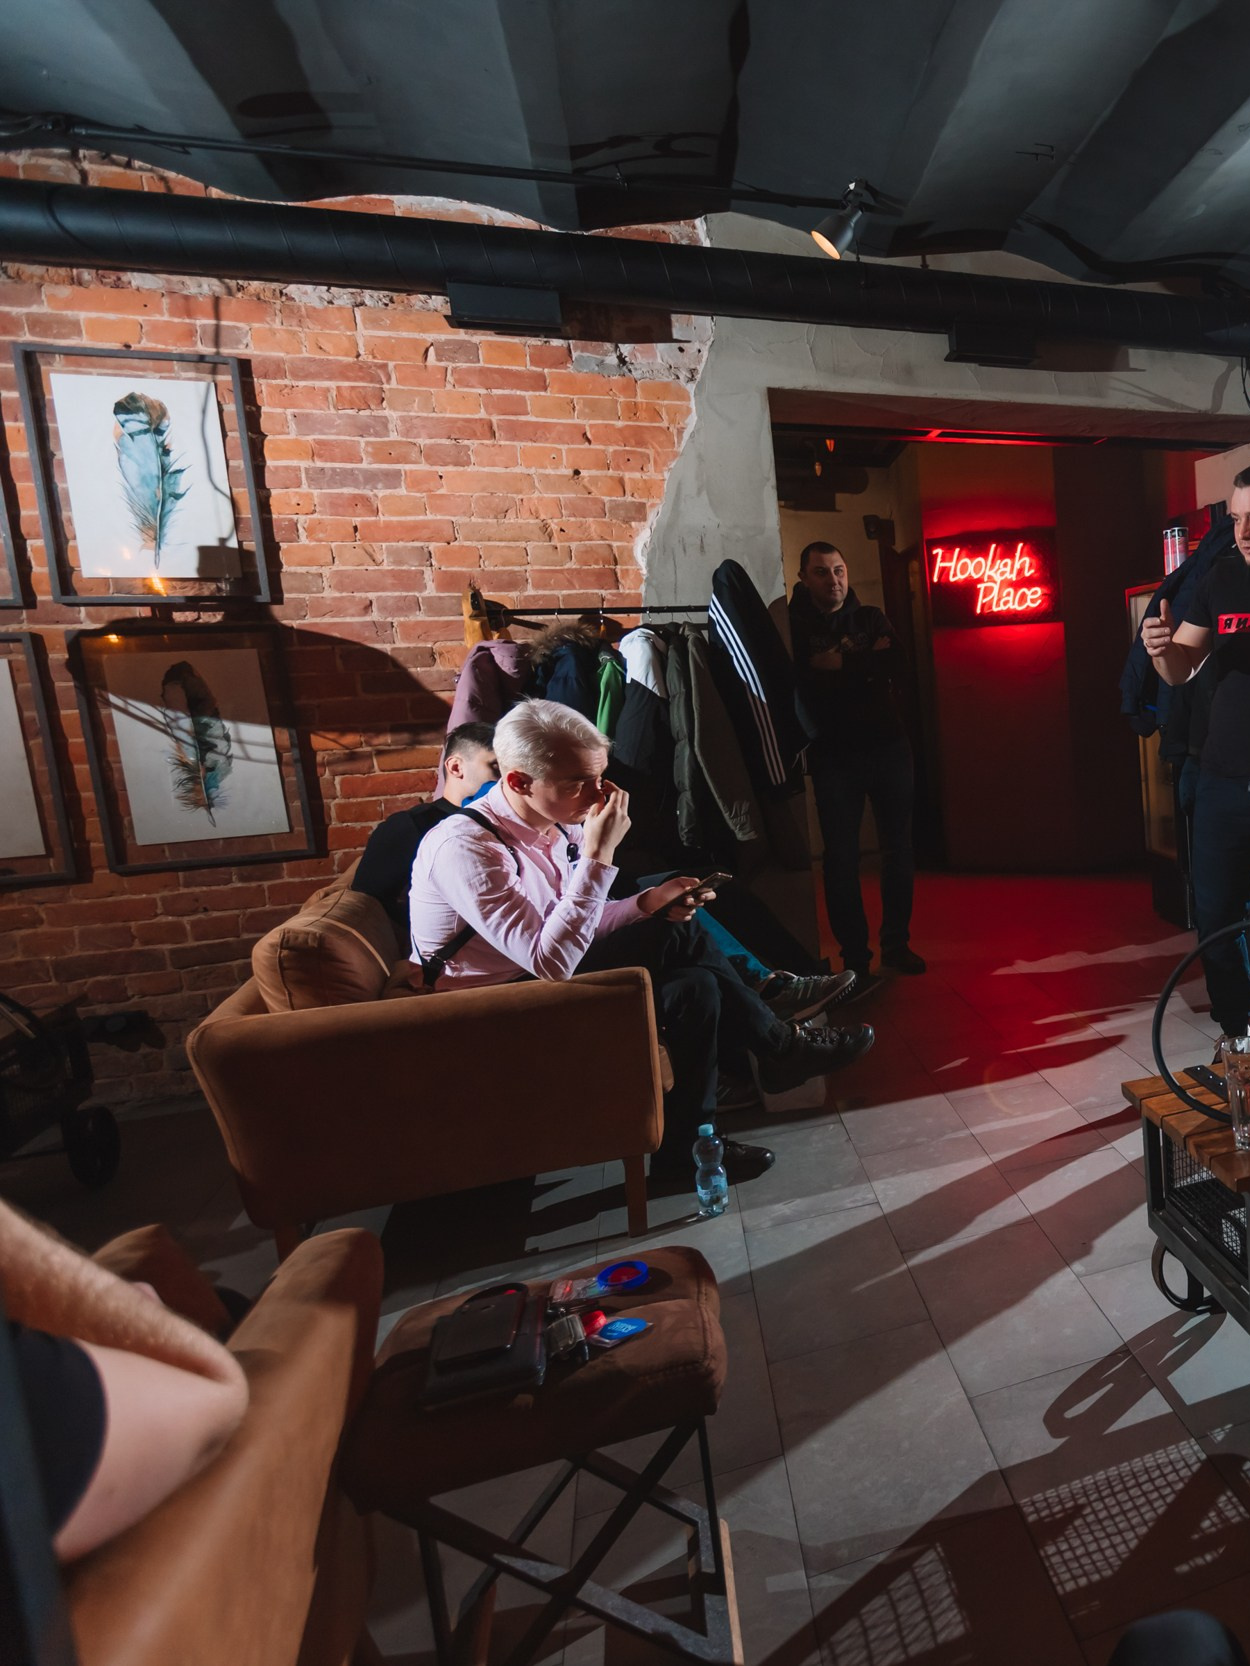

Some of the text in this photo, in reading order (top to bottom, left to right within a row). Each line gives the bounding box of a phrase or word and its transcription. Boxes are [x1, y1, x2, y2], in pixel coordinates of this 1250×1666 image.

[932, 543, 1035, 582] Hookah
[976, 579, 1042, 614] Place
[1223, 617, 1234, 629] Я
